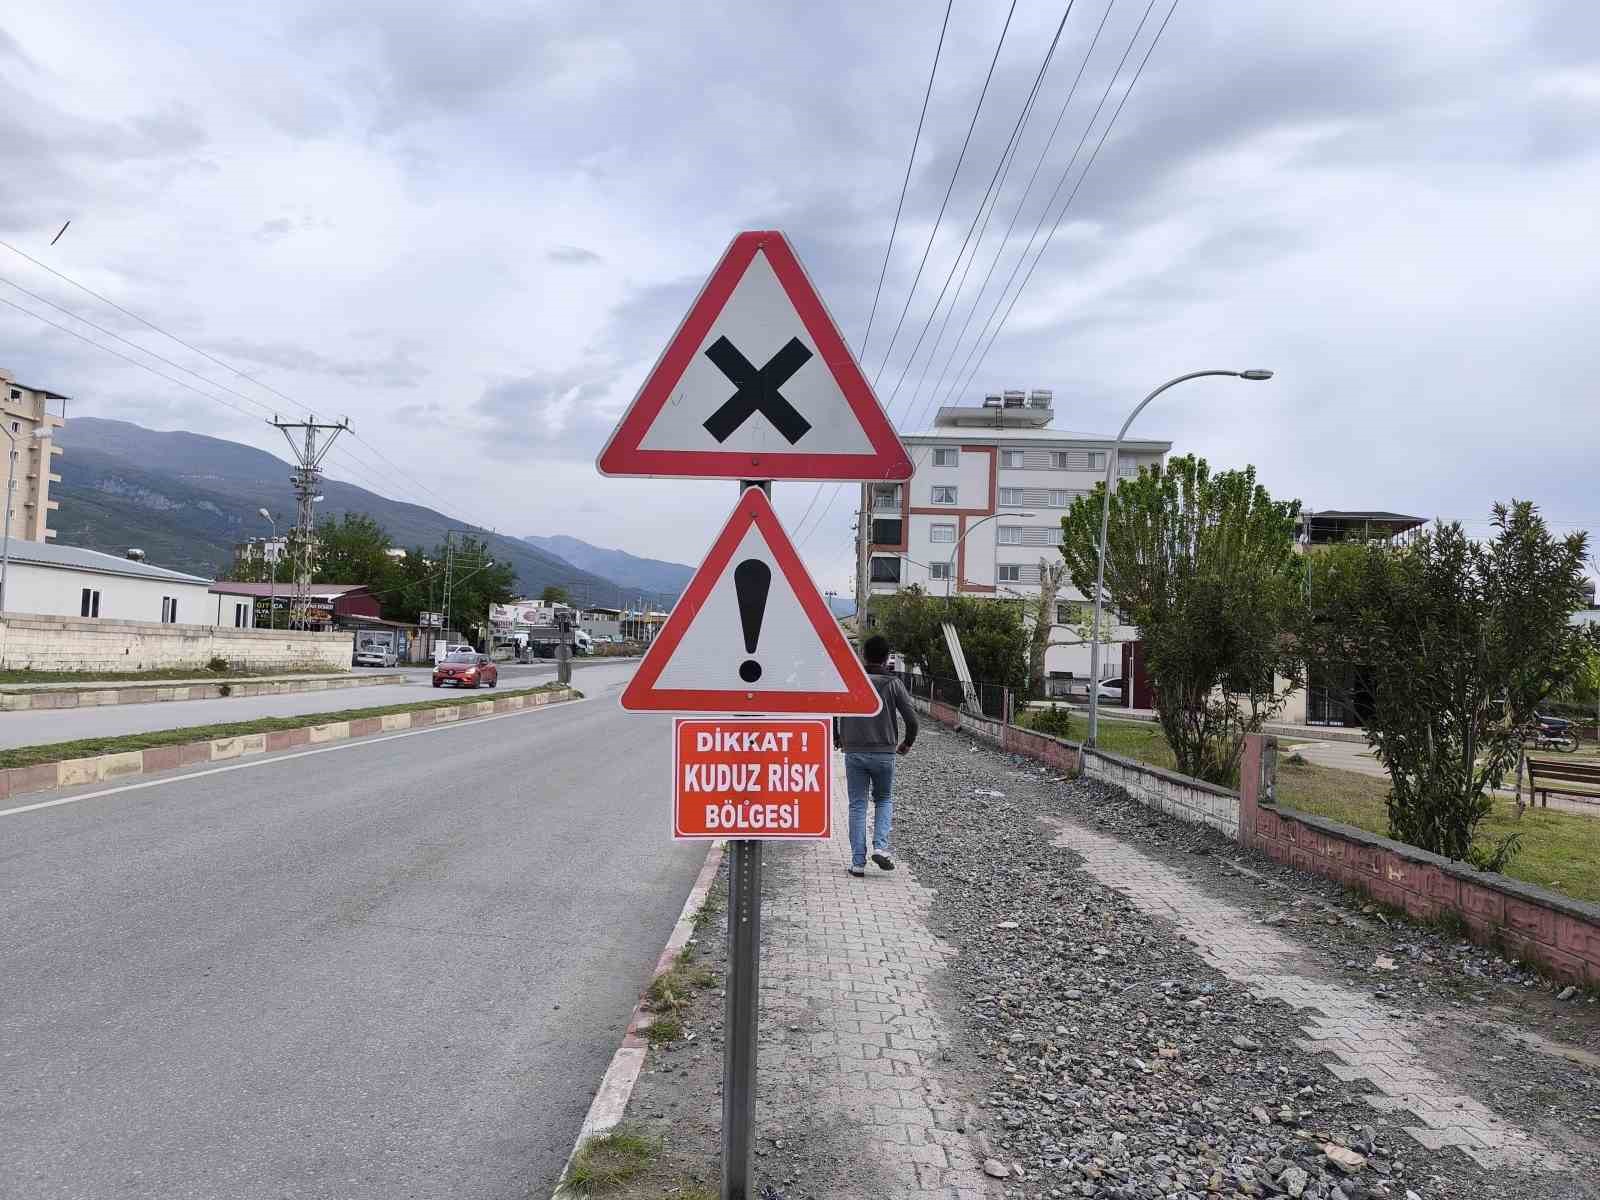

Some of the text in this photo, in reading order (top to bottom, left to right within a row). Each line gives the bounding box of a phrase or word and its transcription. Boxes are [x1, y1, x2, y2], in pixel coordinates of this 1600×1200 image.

[696, 727, 793, 752] DİKKAT
[684, 757, 820, 792] KUDUZ RİSK
[705, 799, 800, 829] BÖLGESİ
